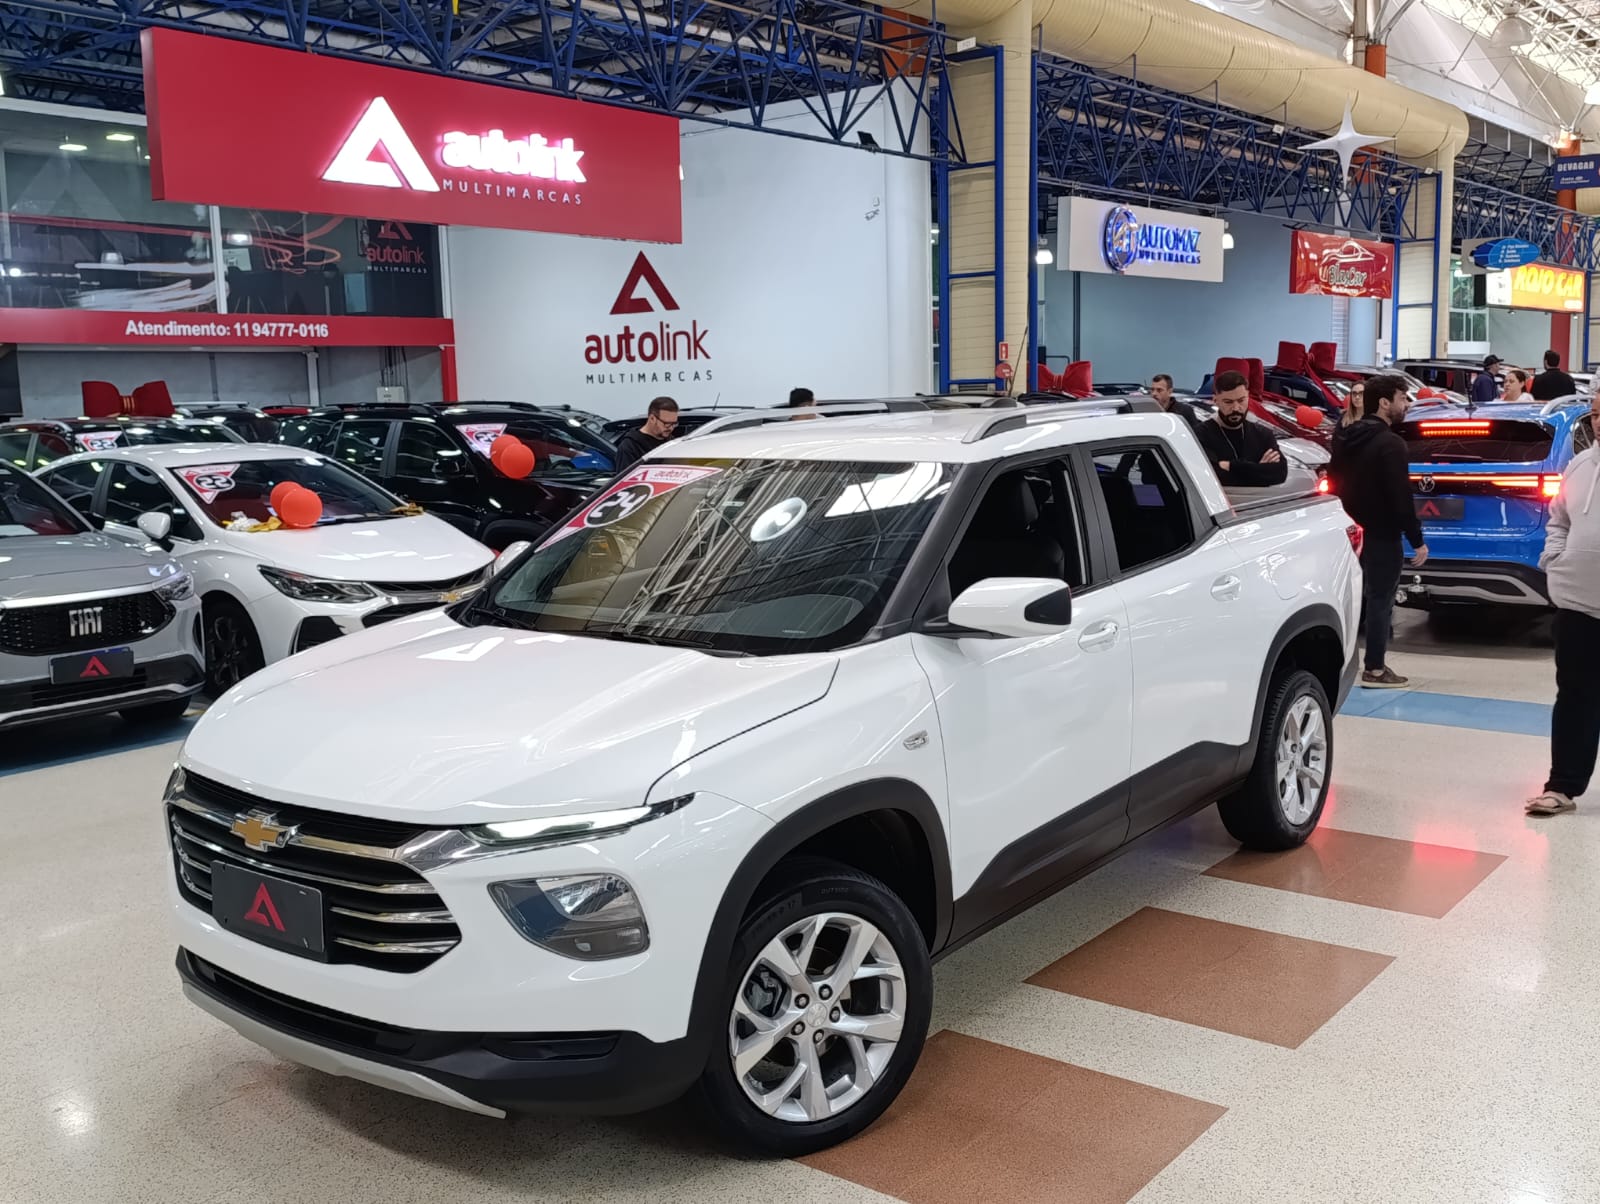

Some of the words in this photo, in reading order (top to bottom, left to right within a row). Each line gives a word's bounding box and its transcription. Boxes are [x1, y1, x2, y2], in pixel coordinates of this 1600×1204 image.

[441, 129, 587, 183] autolink
[1557, 161, 1595, 172] DEVAGAR
[442, 178, 582, 205] MULTIMARCAS
[366, 245, 426, 264] autolink
[1137, 249, 1201, 265] MULTIMARCAS
[367, 265, 427, 274] MULTIMARCAS
[1556, 271, 1583, 299] CAR
[125, 319, 231, 337] Atendimento:
[233, 322, 250, 337] 11
[252, 322, 329, 338] 94777-0116
[584, 319, 712, 365] autolink
[586, 369, 713, 384] MULTIMARCAS
[589, 491, 648, 519] 24
[68, 606, 103, 637] FIAT
